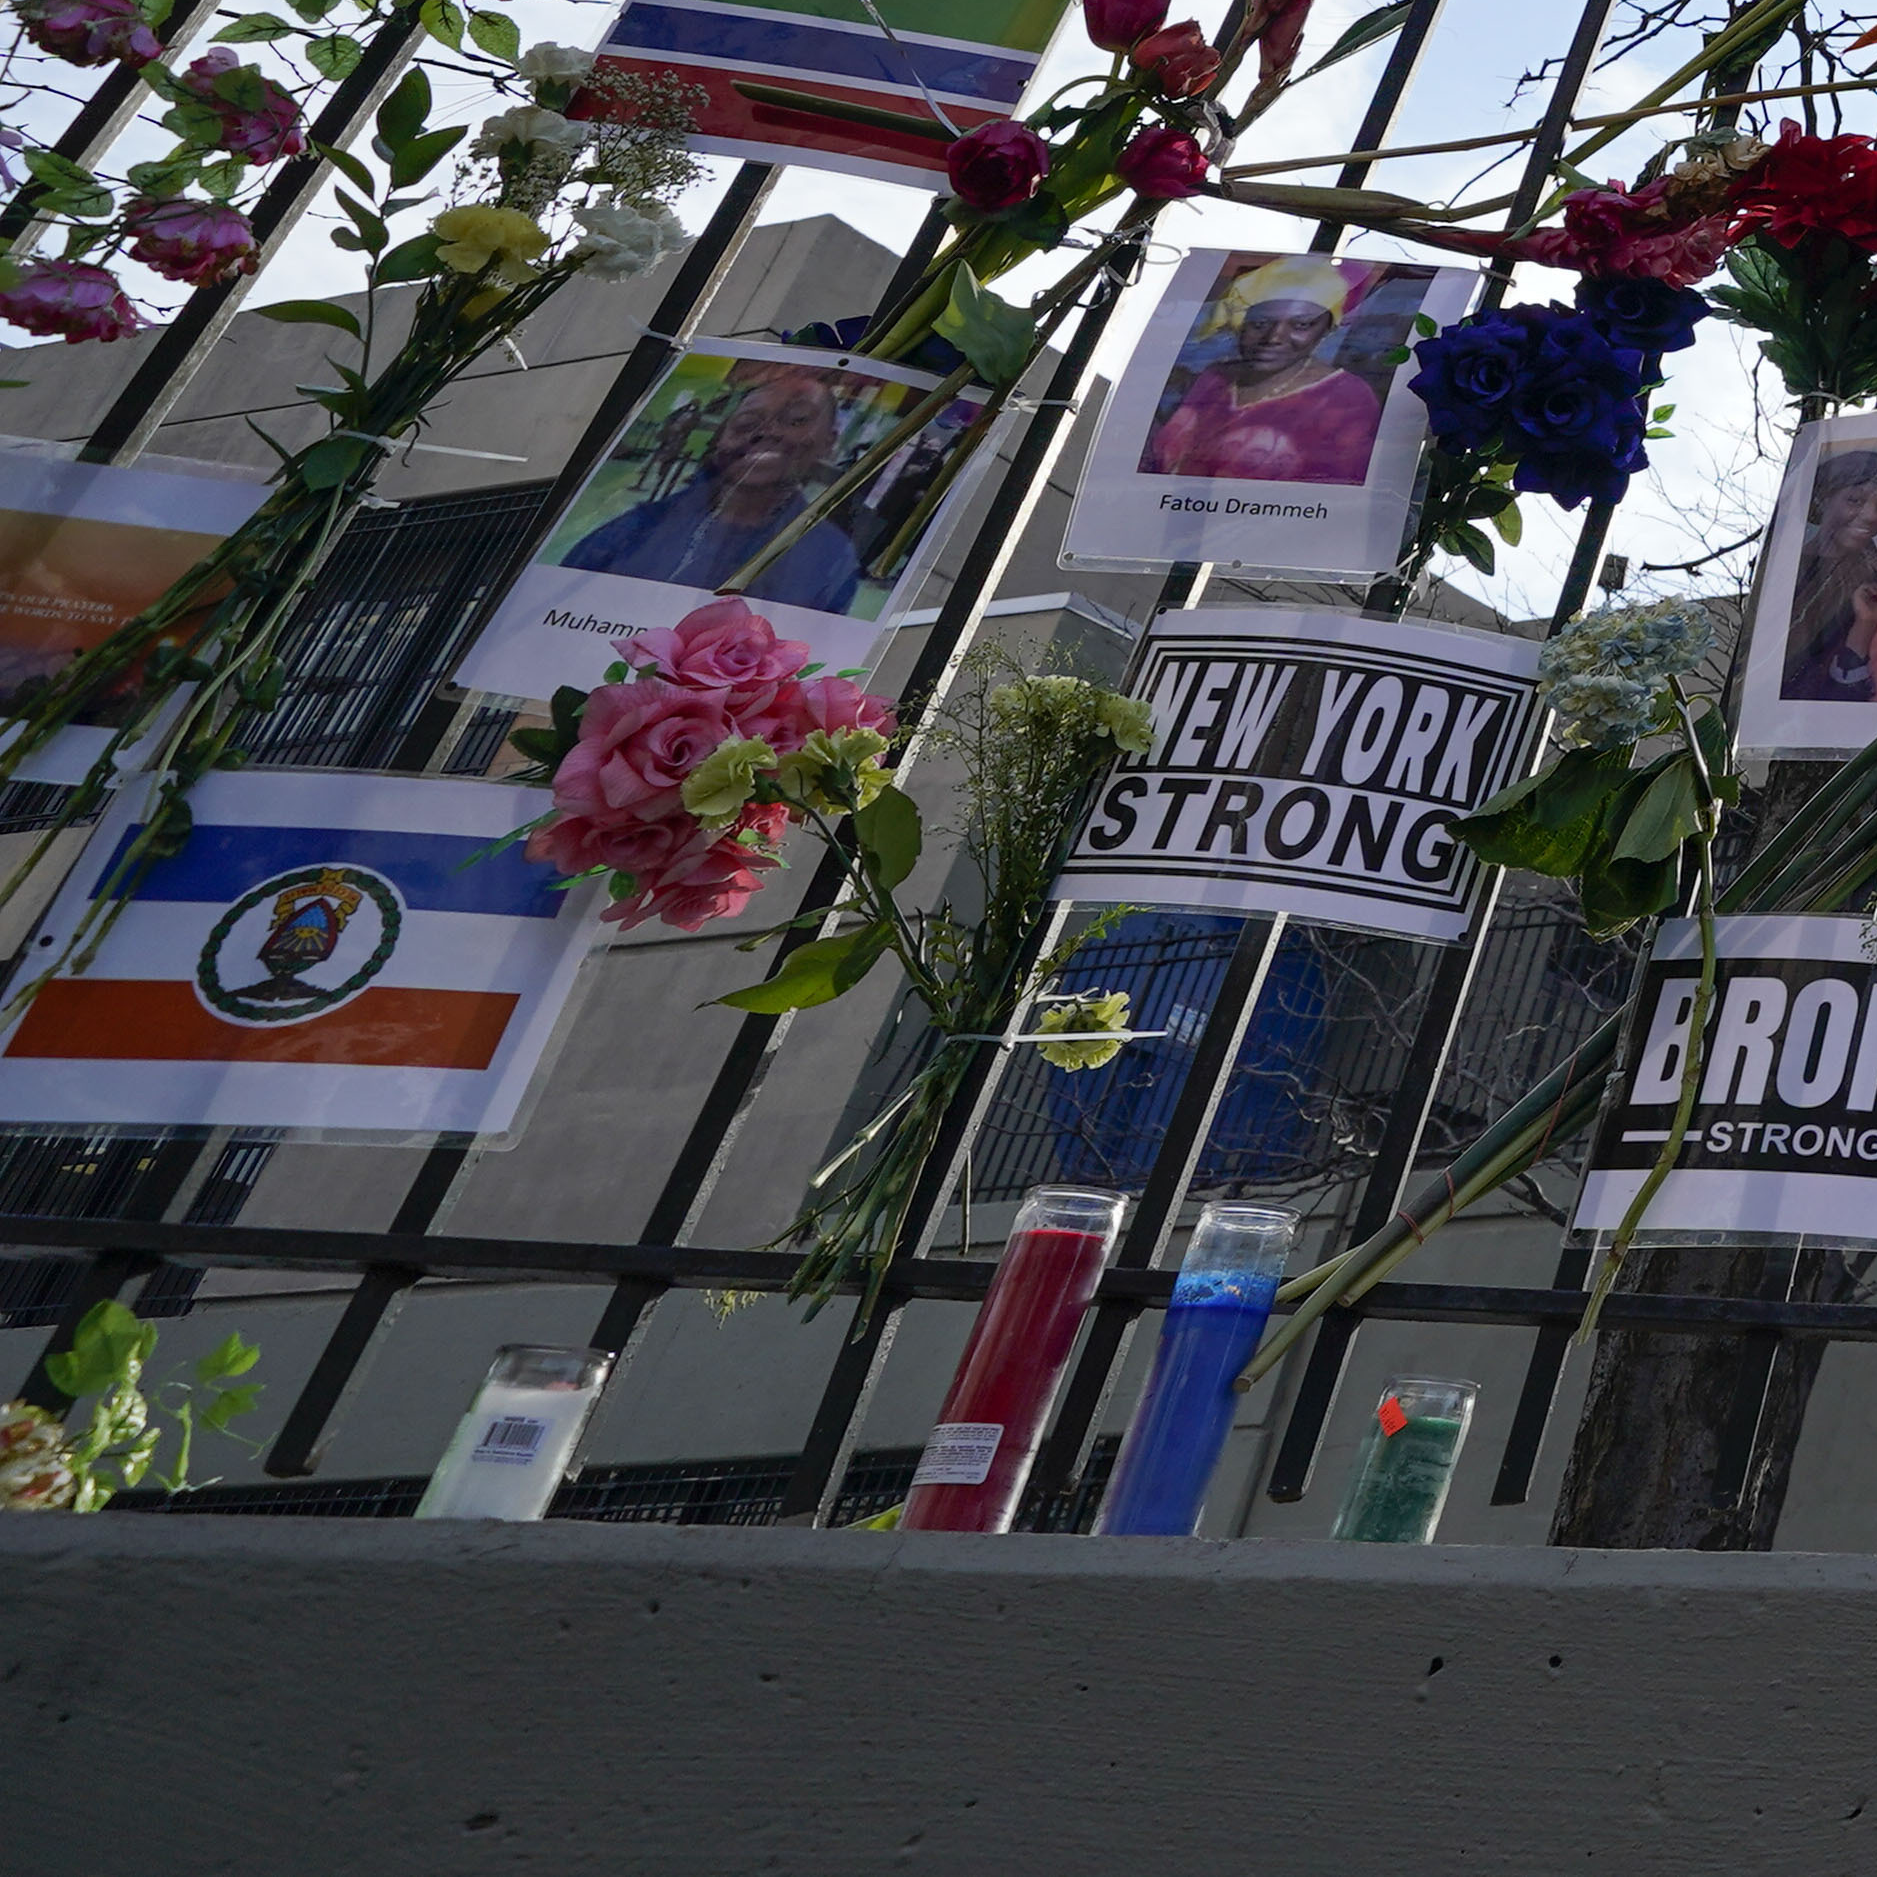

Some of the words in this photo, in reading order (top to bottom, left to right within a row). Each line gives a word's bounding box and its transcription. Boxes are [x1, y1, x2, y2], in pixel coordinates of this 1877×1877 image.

[1159, 494, 1219, 513] Fatou
[1225, 498, 1328, 519] Drammeh
[13, 605, 62, 619] WORDS
[67, 611, 88, 621] TO
[90, 614, 117, 626] SAY
[53, 598, 114, 614] PRAYERS
[543, 609, 648, 637] Muham
[1130, 660, 1298, 769] NEW
[1300, 667, 1502, 804] YORK
[1089, 776, 1465, 883] STRONG
